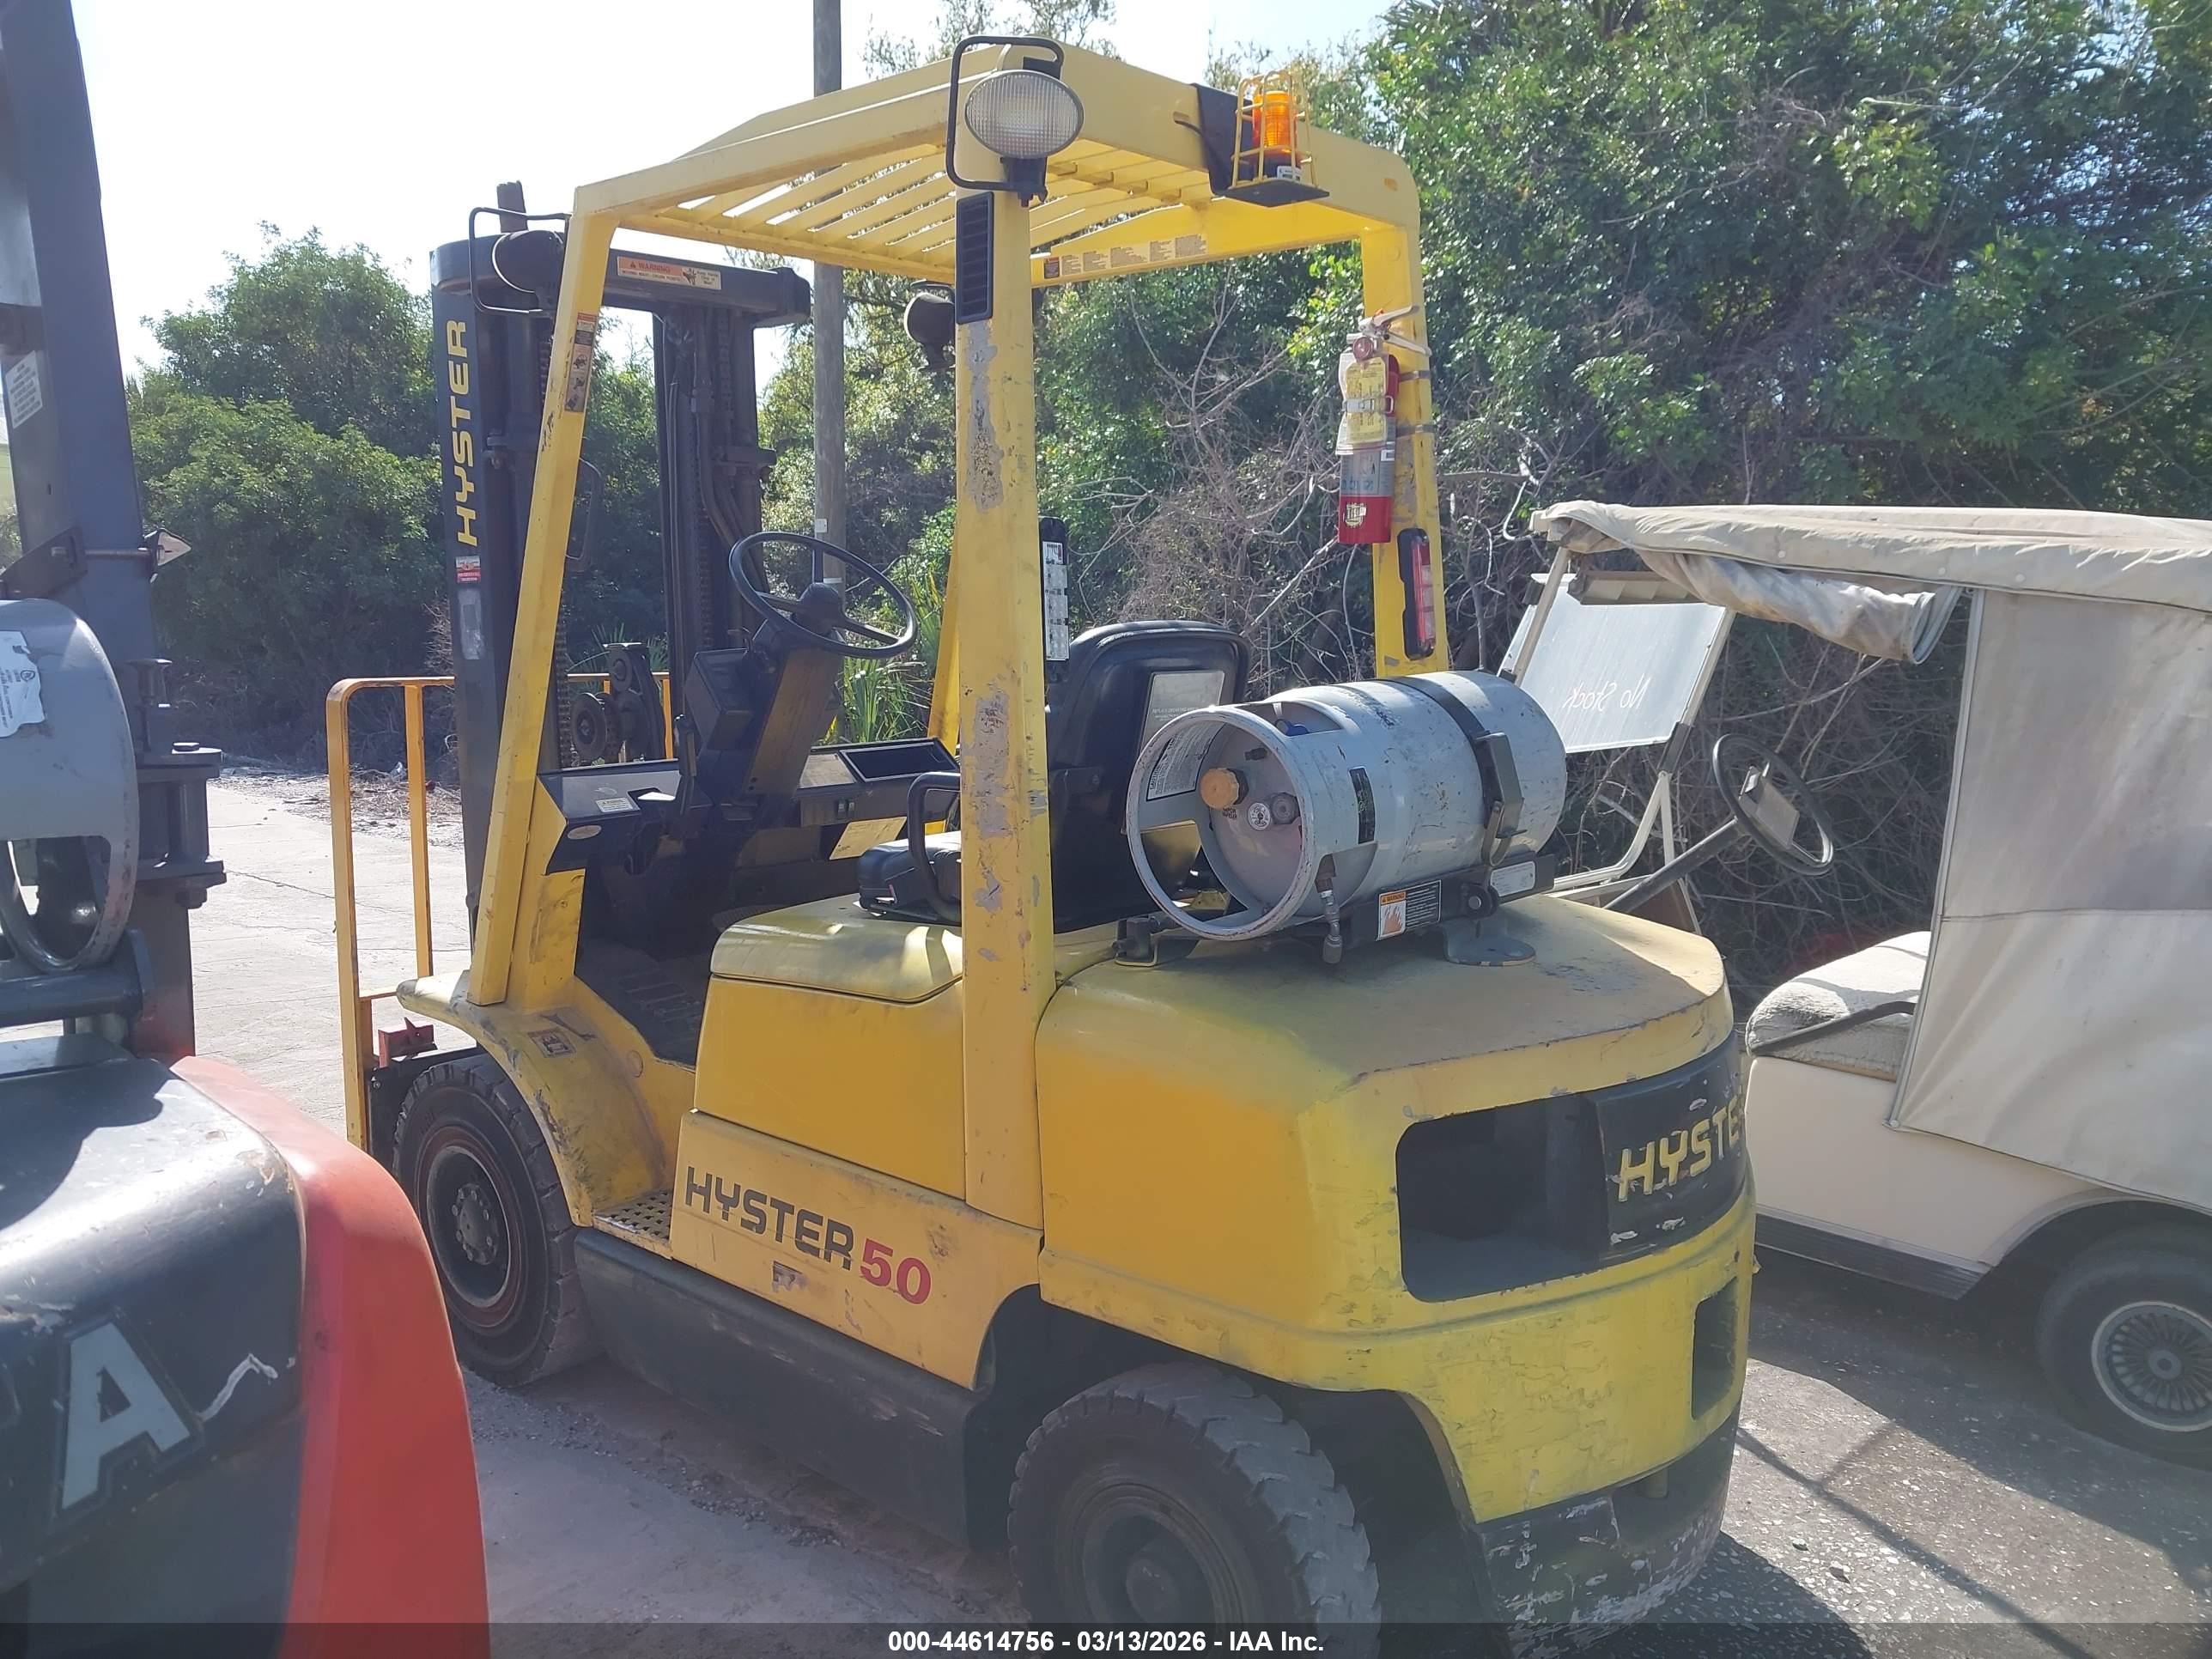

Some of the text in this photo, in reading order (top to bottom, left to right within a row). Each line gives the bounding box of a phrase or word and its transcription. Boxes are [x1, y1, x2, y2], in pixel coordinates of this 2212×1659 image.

[447, 319, 478, 548] HYSTER
[1619, 1088, 1745, 1202] HYSTE
[685, 1166, 932, 1305] HYSTER 50
